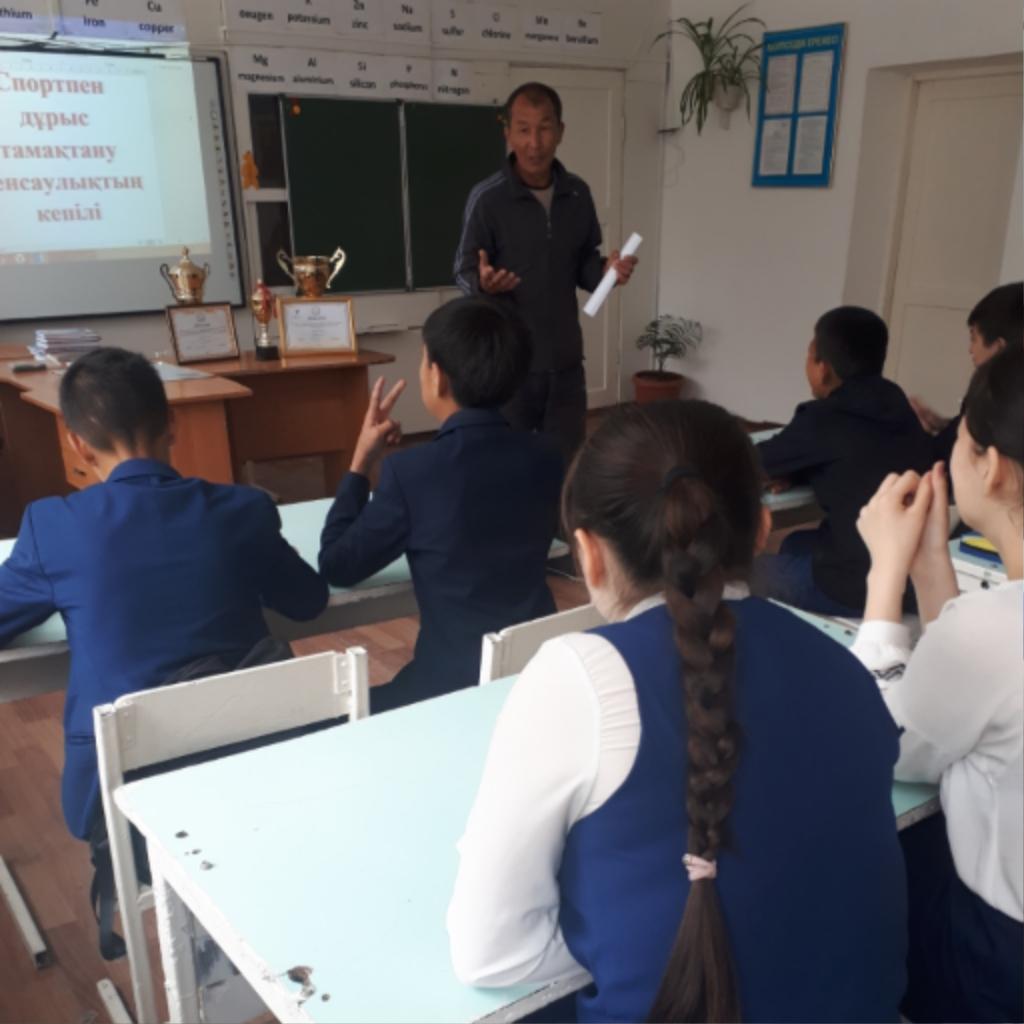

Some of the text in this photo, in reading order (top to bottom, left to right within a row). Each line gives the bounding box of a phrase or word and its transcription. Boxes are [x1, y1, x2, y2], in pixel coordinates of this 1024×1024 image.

[139, 22, 174, 34] copper
[20, 110, 90, 131] дұрыс
[37, 202, 103, 223] кепілі
